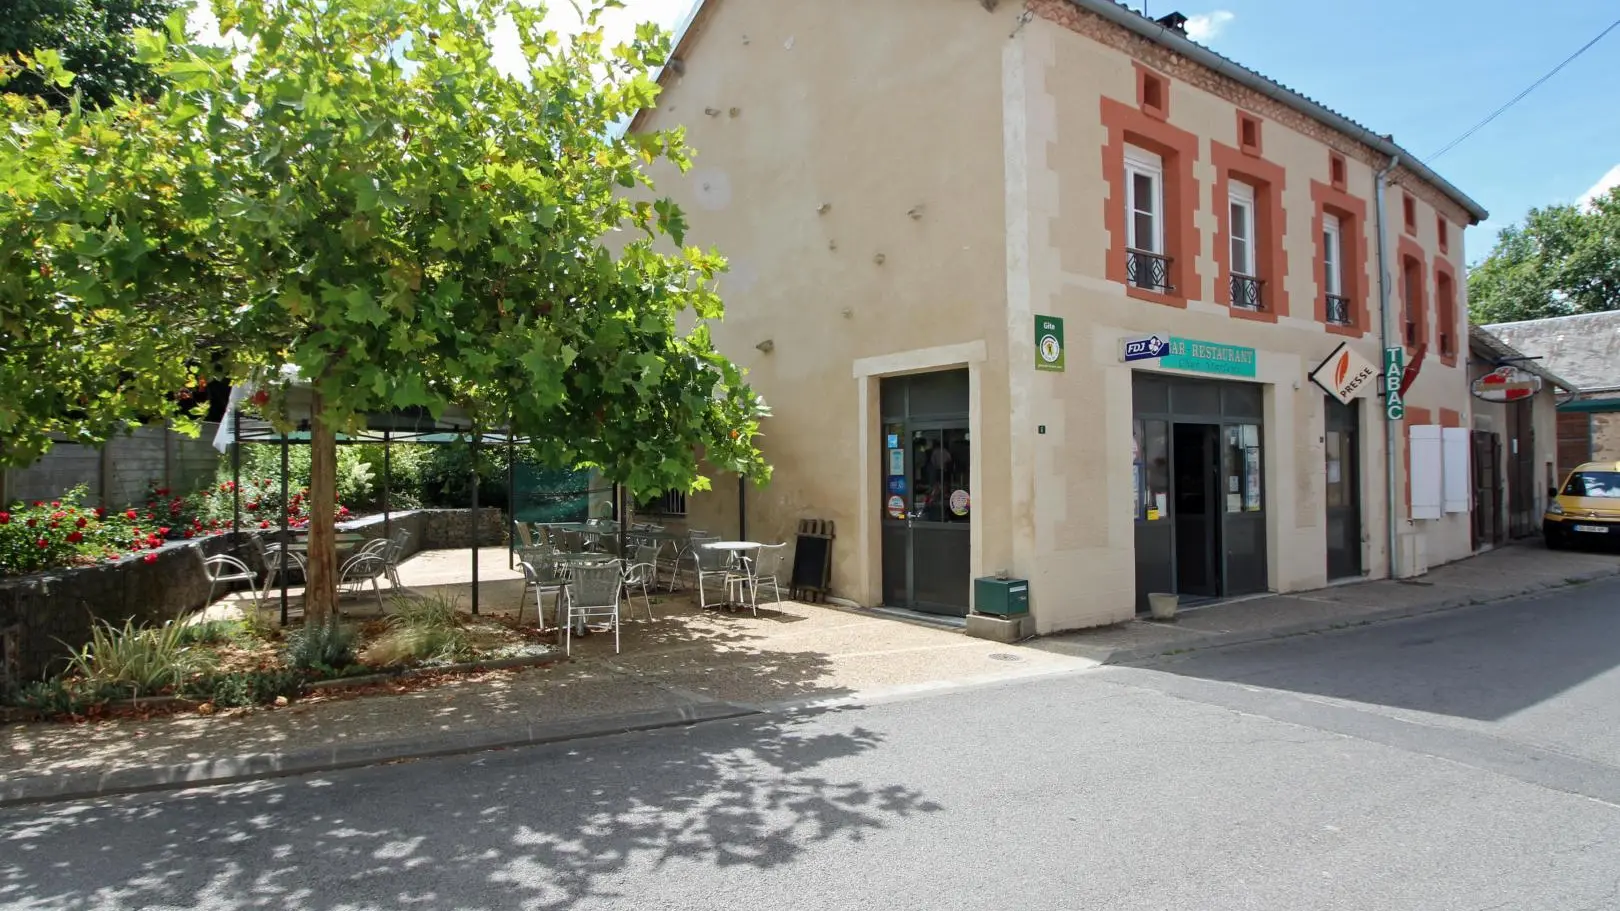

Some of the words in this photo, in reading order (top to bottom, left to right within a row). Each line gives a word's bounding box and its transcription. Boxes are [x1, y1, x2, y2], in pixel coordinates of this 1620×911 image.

[1128, 342, 1145, 353] FDJ
[1192, 343, 1253, 363] RESTAURANT
[1340, 367, 1373, 398] PRESSE
[1387, 348, 1403, 419] TABAC
